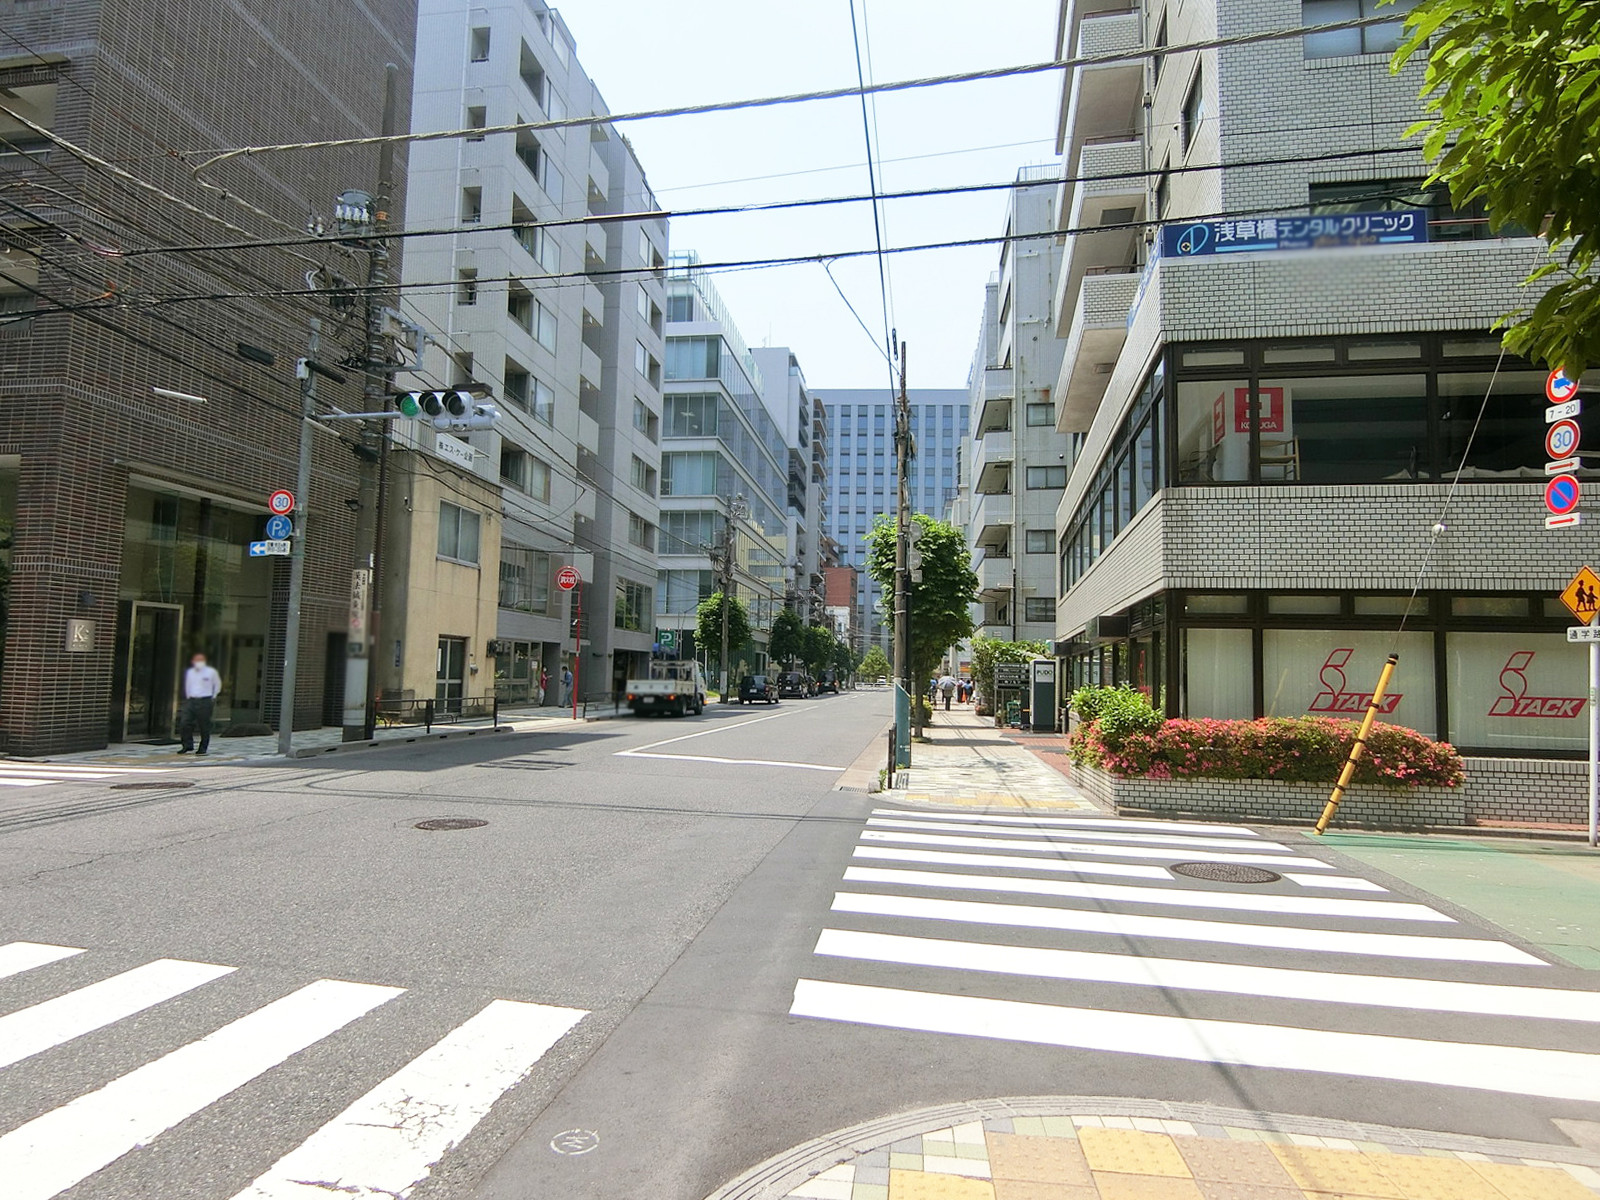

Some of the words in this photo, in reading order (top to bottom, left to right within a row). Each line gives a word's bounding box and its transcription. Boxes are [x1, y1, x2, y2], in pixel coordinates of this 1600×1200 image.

[1214, 213, 1415, 243] 浅草橋デンタルクリニック
[1553, 430, 1573, 449] 30
[274, 497, 289, 508] 30
[271, 520, 283, 536] P
